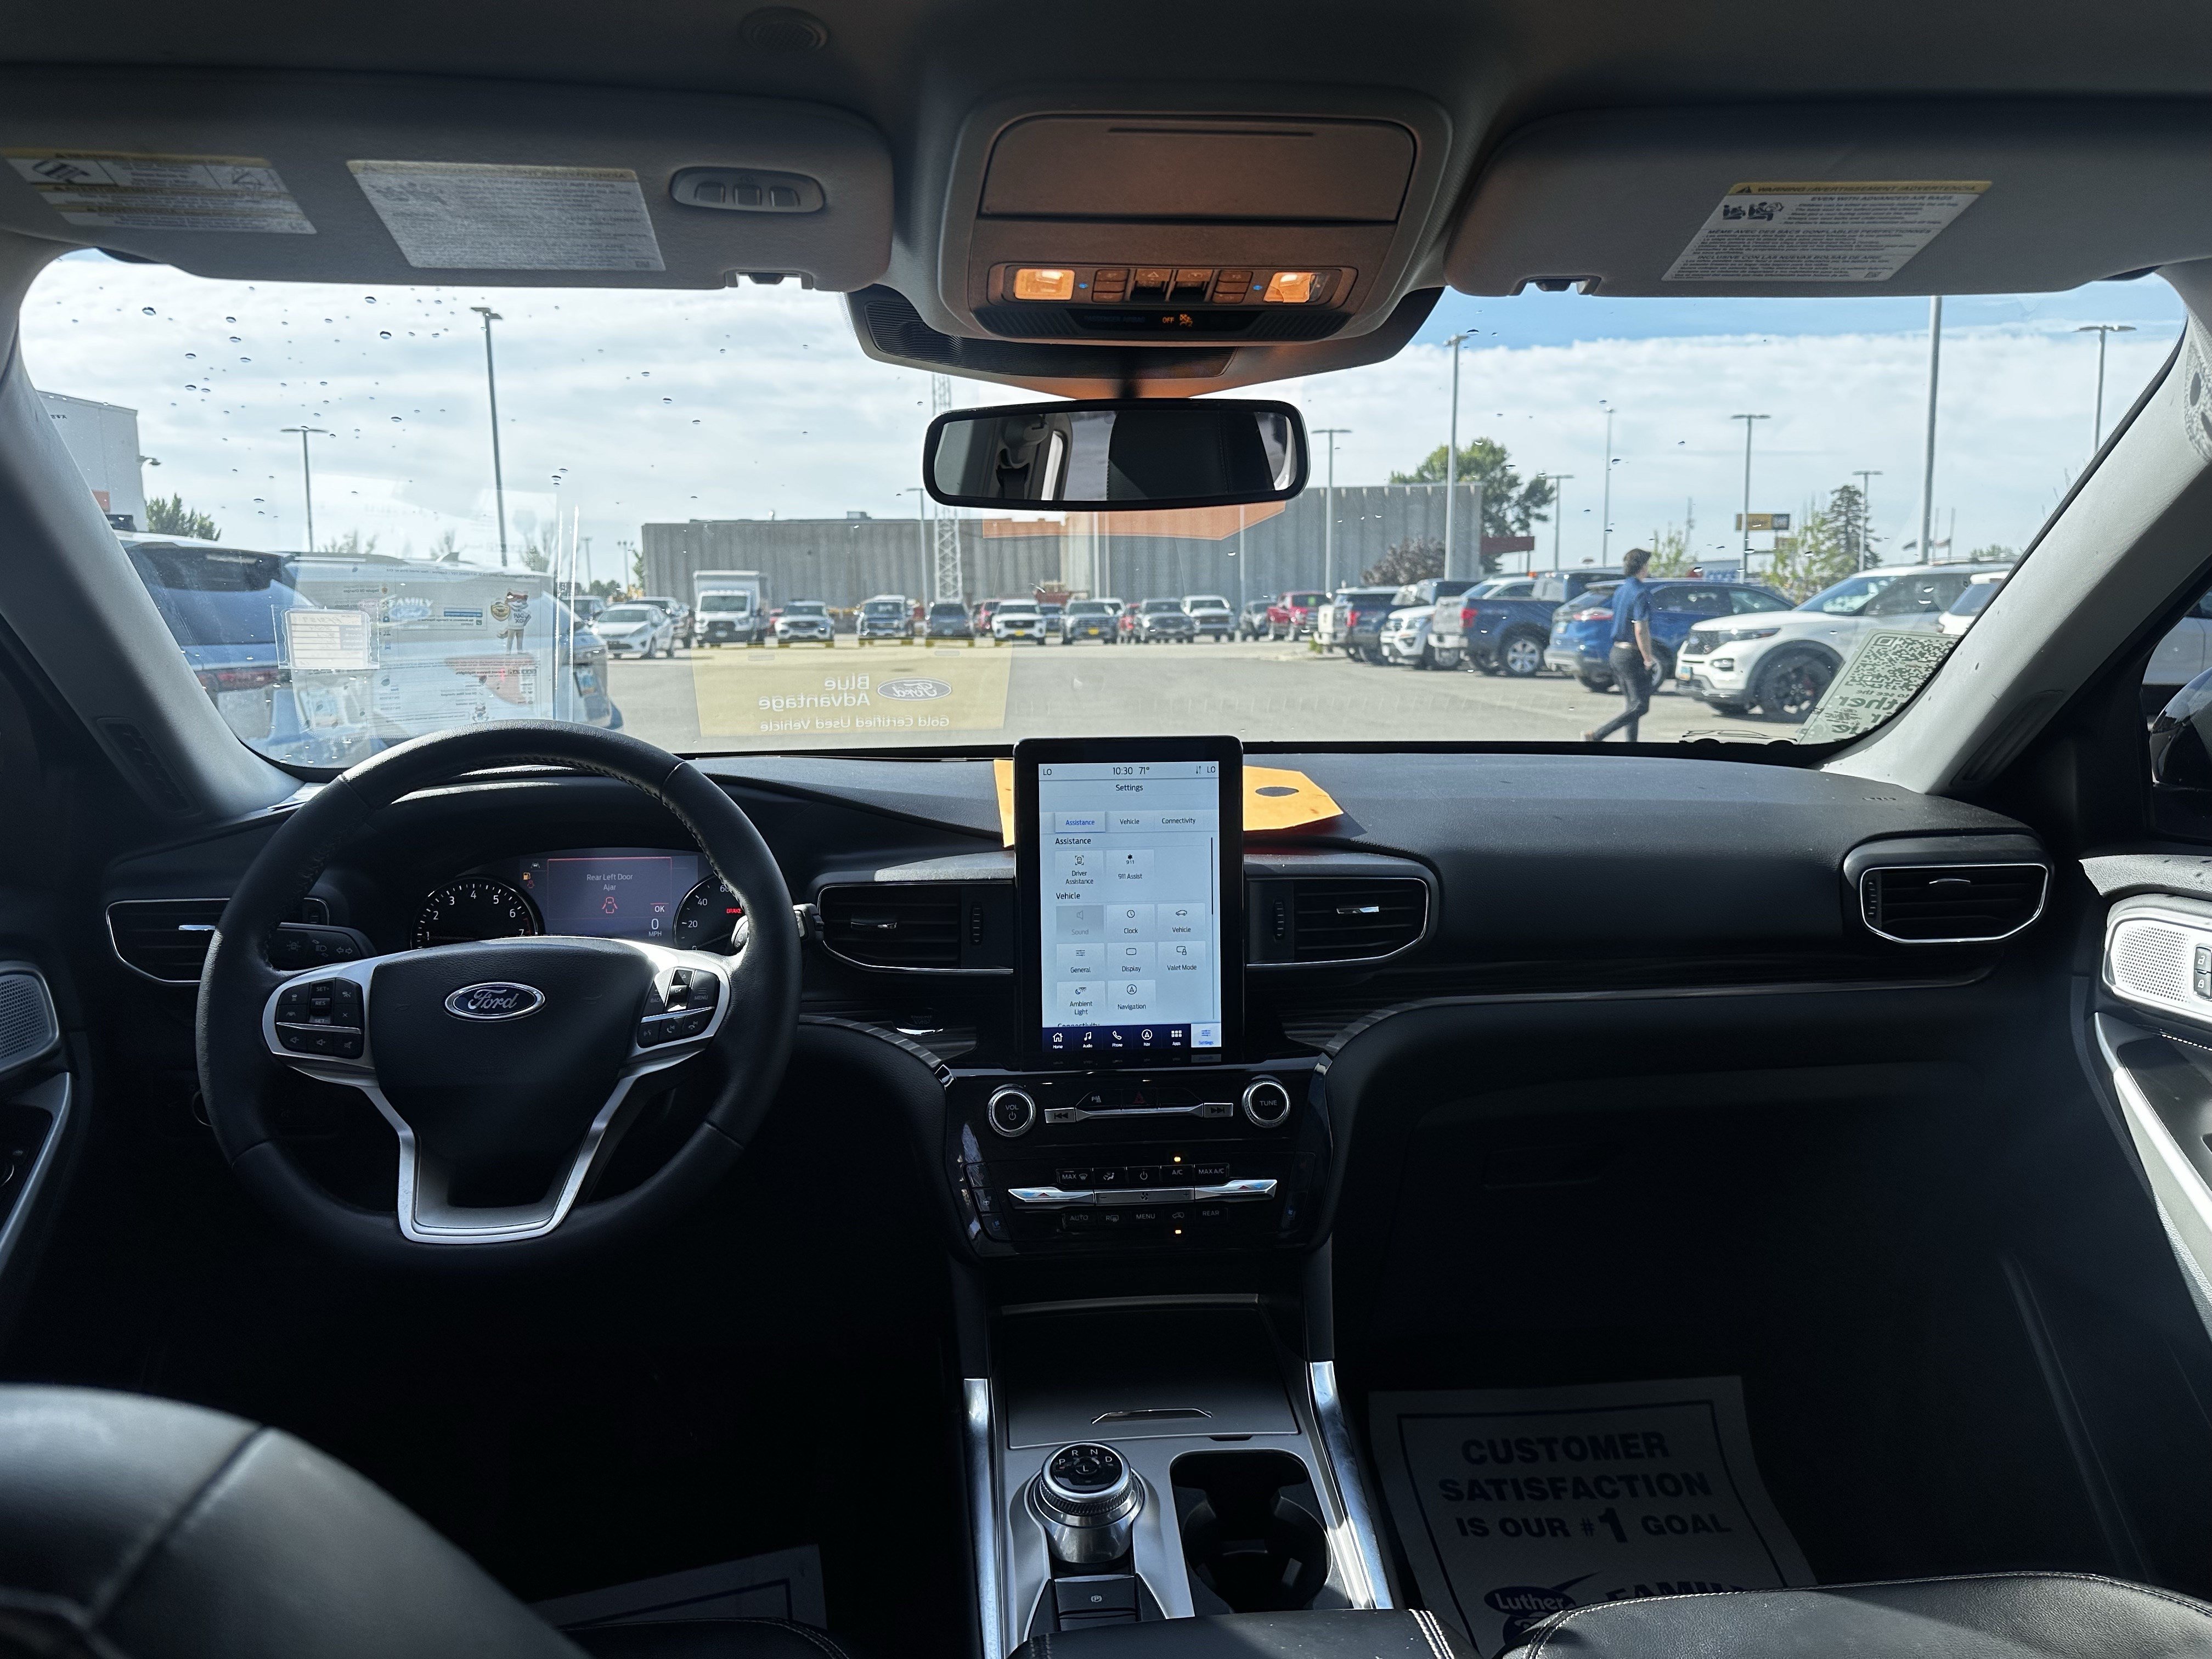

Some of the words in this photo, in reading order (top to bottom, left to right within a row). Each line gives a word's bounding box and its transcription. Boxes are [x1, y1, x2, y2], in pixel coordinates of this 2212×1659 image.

[1113, 766, 1133, 775] 10:30
[1138, 766, 1150, 775] 71°
[603, 883, 617, 892] Ajar
[470, 890, 476, 899] 4
[449, 896, 455, 905] 3
[493, 895, 499, 904] 5
[433, 911, 439, 920] 2
[509, 909, 516, 918] 6
[651, 918, 659, 930] 0
[426, 932, 430, 940] 1
[467, 988, 520, 1010] Ford
[1462, 1431, 1670, 1466] CUSTOMER
[1438, 1472, 1713, 1503] SATISFACTION
[1457, 1517, 1490, 1537] IS
[1499, 1516, 1571, 1537] OUR
[1641, 1513, 1732, 1536] GOAL
[1494, 1591, 1566, 1612] Luther
